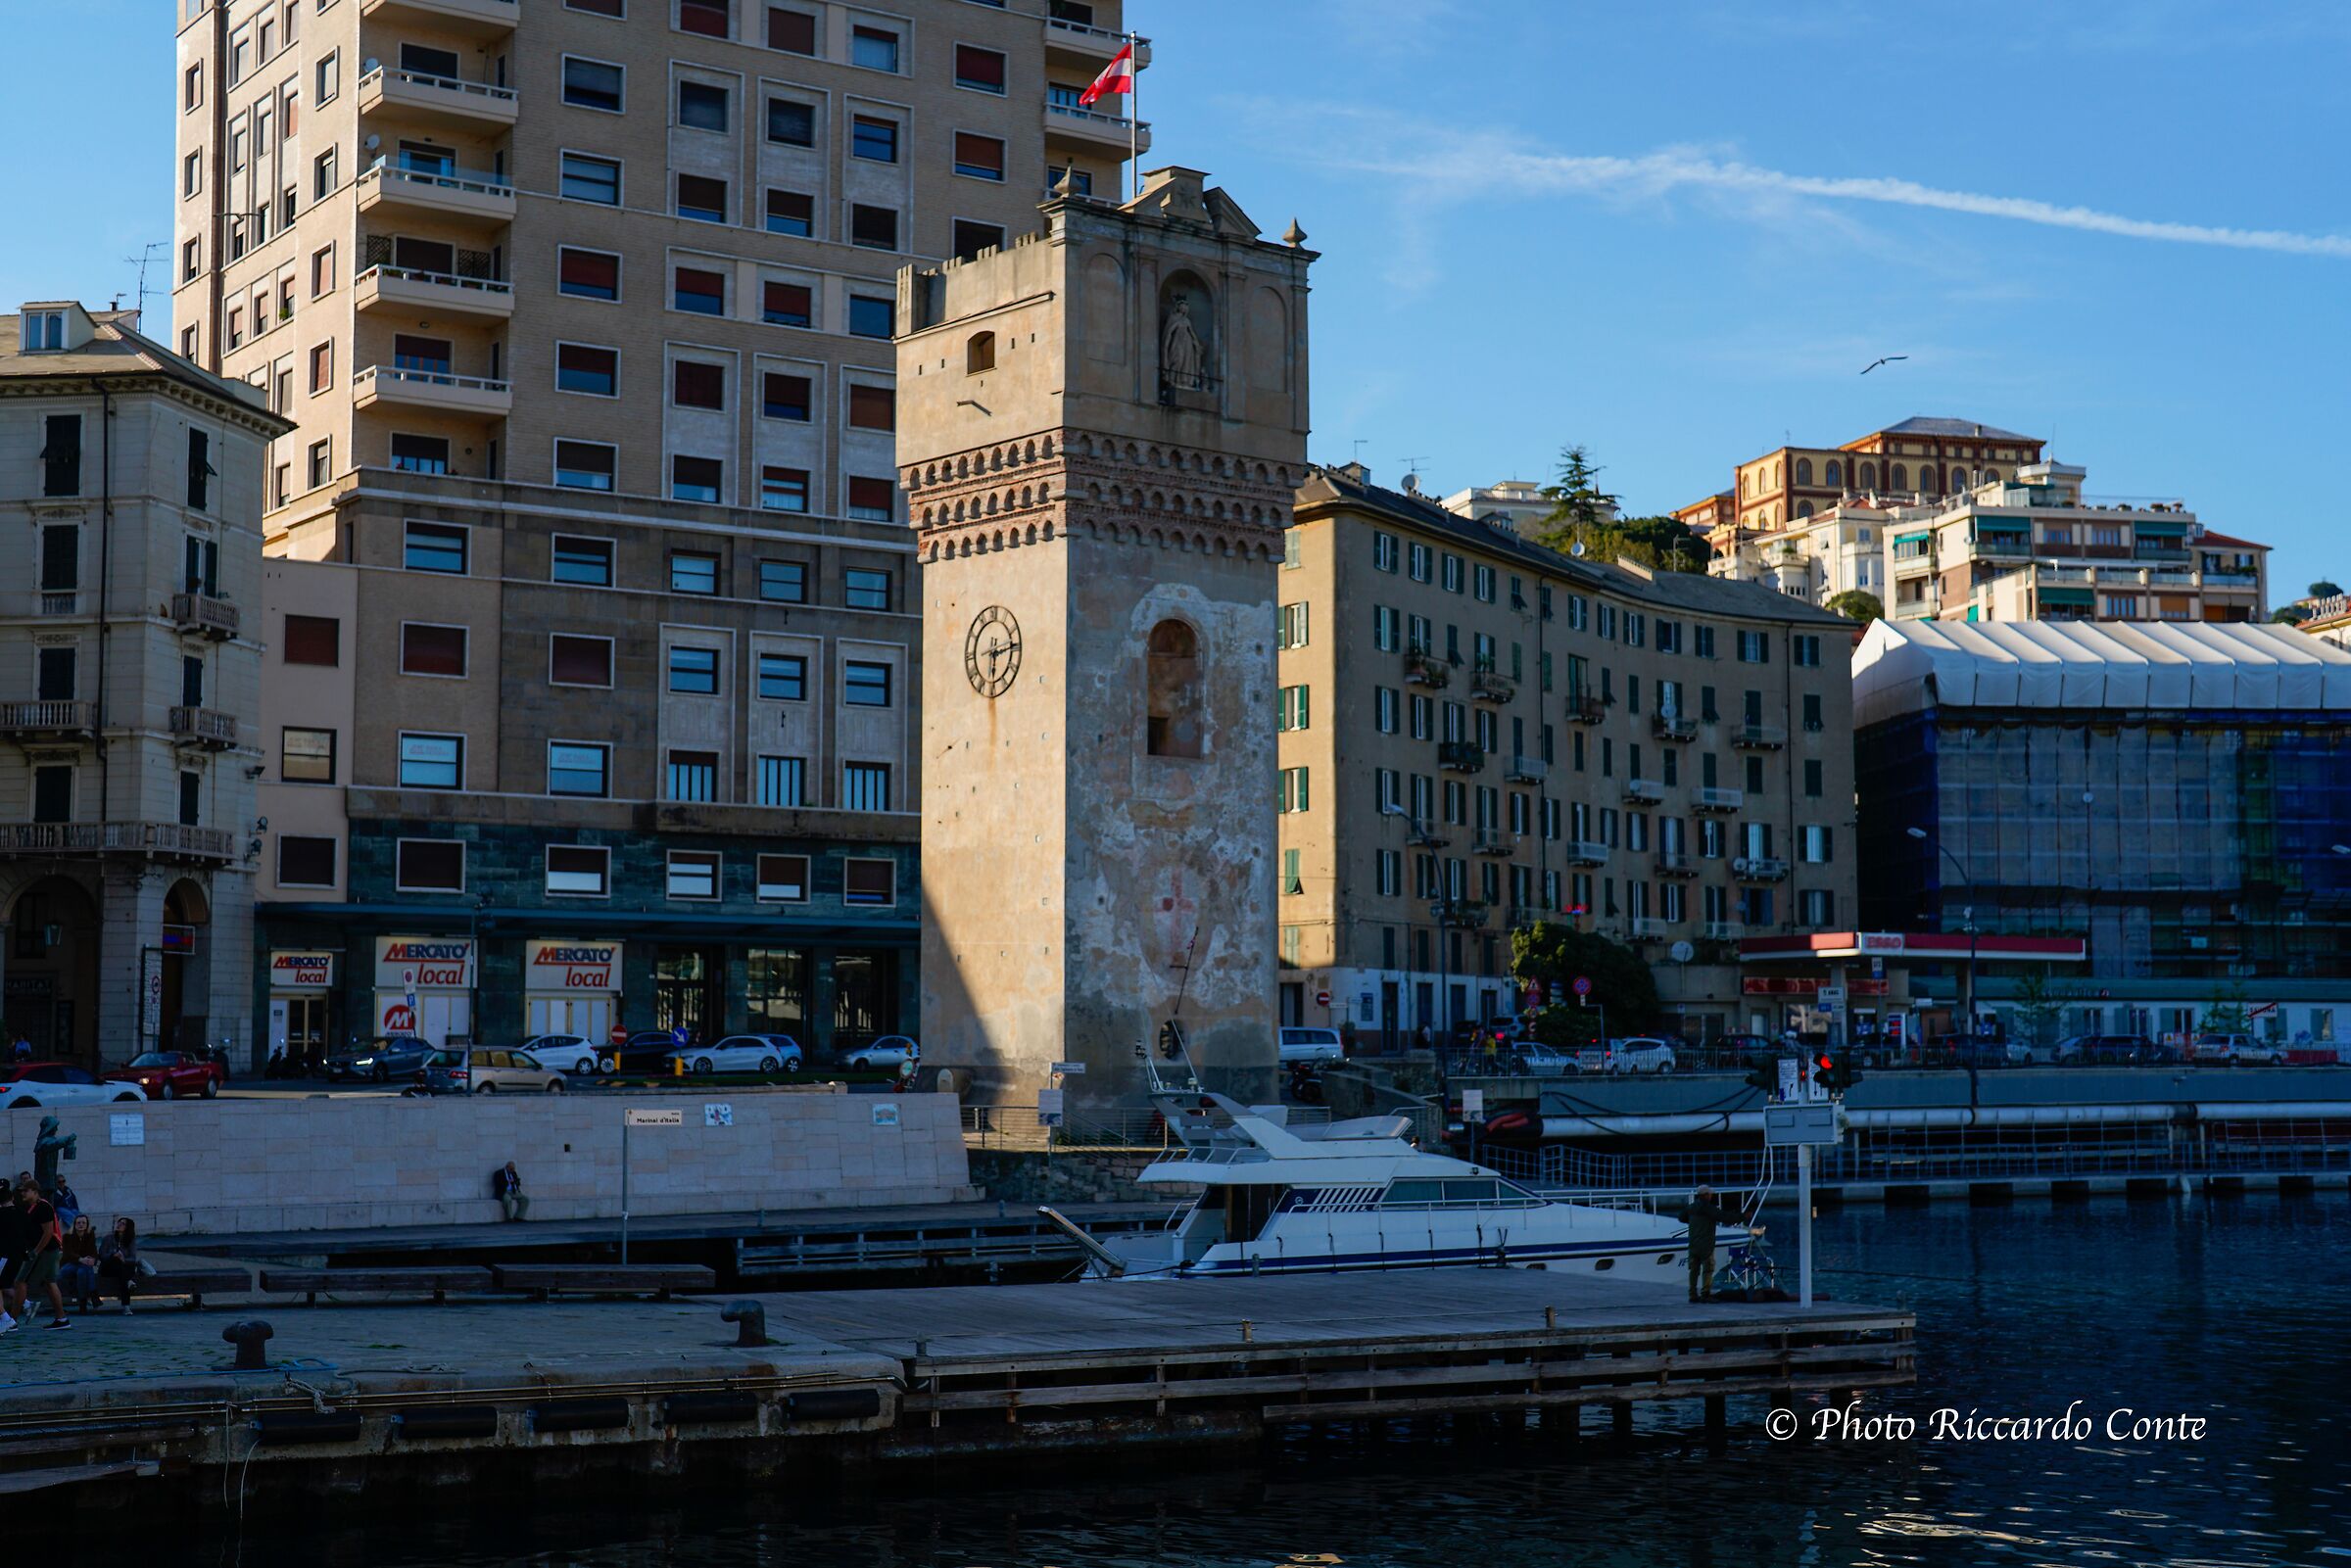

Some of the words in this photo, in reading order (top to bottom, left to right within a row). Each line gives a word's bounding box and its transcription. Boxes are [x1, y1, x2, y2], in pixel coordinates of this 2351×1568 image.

[295, 968, 328, 983] local
[416, 963, 465, 985] local
[565, 967, 610, 987] local
